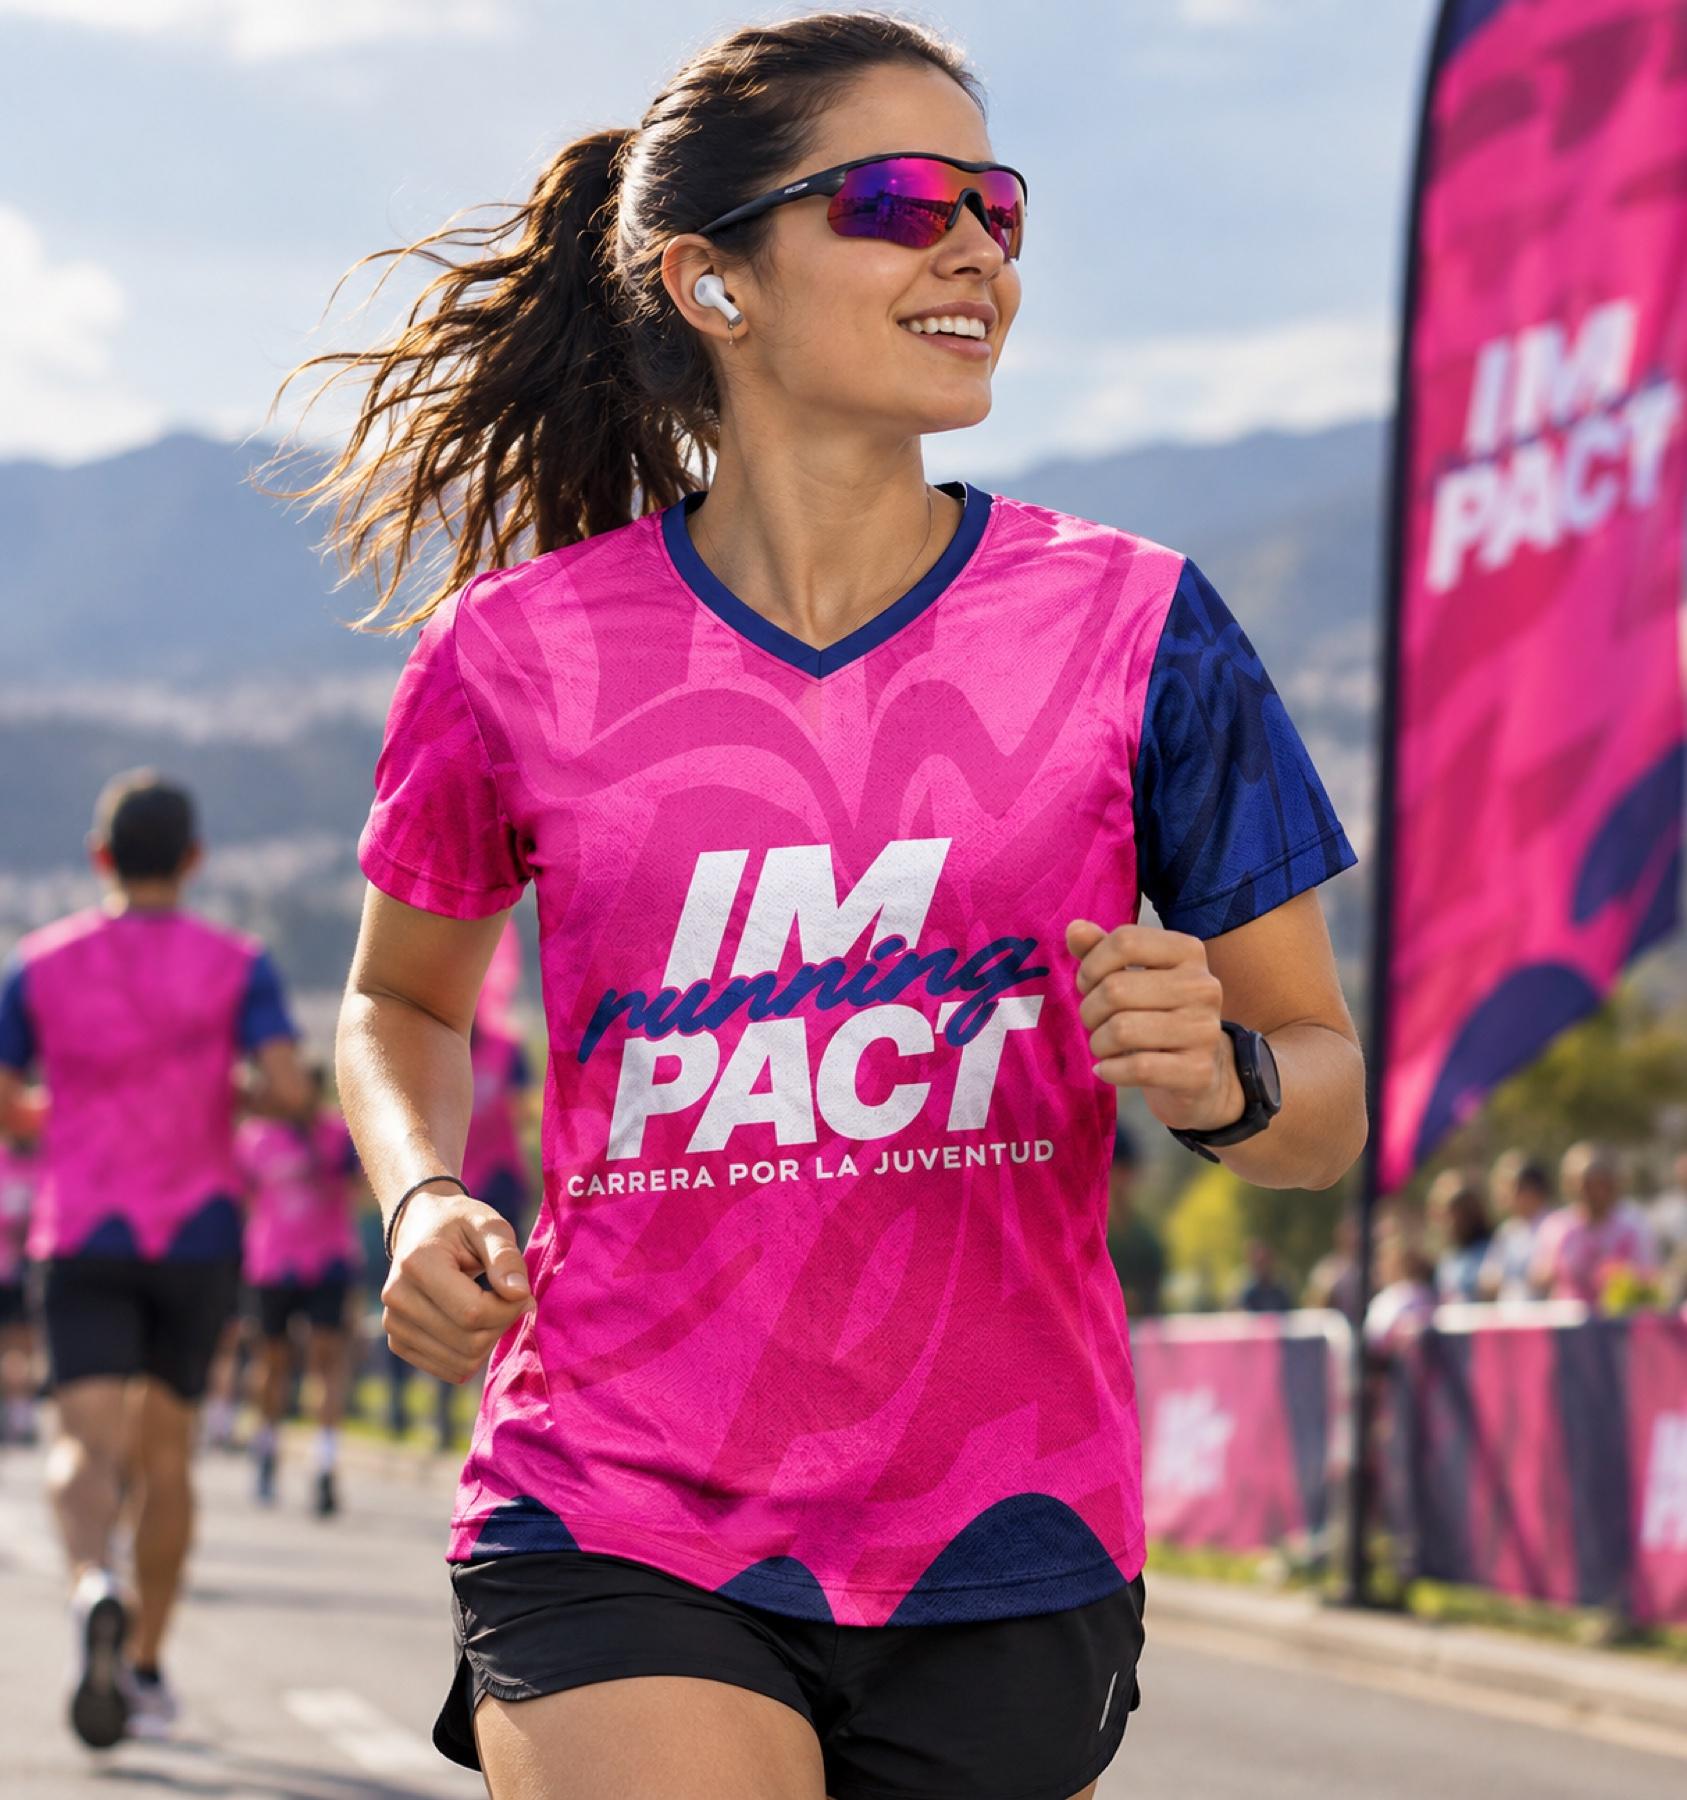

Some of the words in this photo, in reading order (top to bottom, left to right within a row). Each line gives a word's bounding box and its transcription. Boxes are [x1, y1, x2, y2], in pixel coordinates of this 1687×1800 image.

[1427, 379, 1681, 593] PACT
[661, 837, 952, 989] IM
[577, 935, 1049, 1063] running
[606, 995, 1045, 1161] PACT
[567, 1165, 715, 1198] CARRERA
[729, 1159, 800, 1186] POR
[816, 1152, 859, 1180] LA
[874, 1139, 1055, 1175] JUVENTUD
